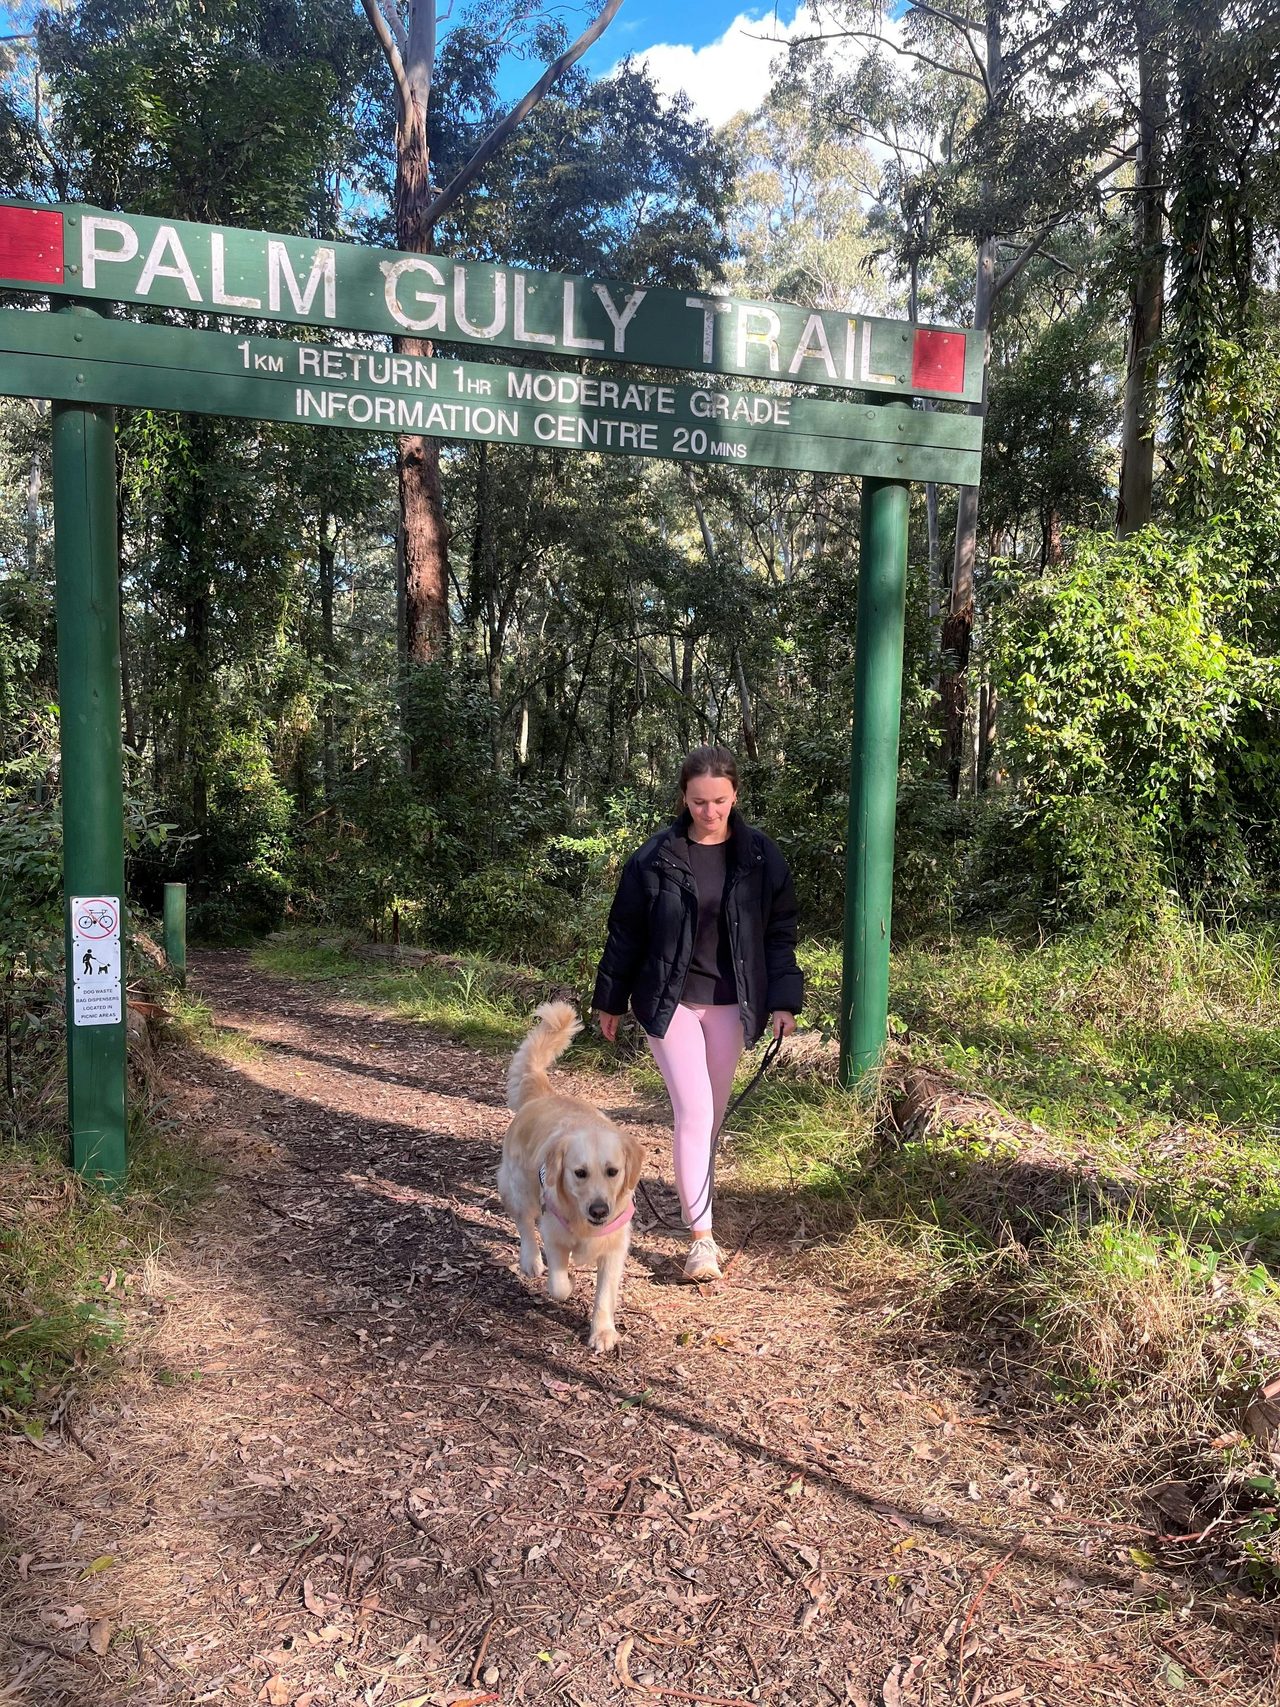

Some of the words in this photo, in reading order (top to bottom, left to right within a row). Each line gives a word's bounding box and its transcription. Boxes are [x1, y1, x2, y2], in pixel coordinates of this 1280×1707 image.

[81, 215, 337, 318] PALM
[384, 258, 647, 353] GULLY
[686, 297, 896, 385] TRAIL
[296, 388, 519, 437] INFORMATION
[534, 413, 659, 450] CENTRE
[299, 347, 437, 390] RETURN
[508, 372, 676, 414] MODERATE
[690, 391, 790, 426] GRADE
